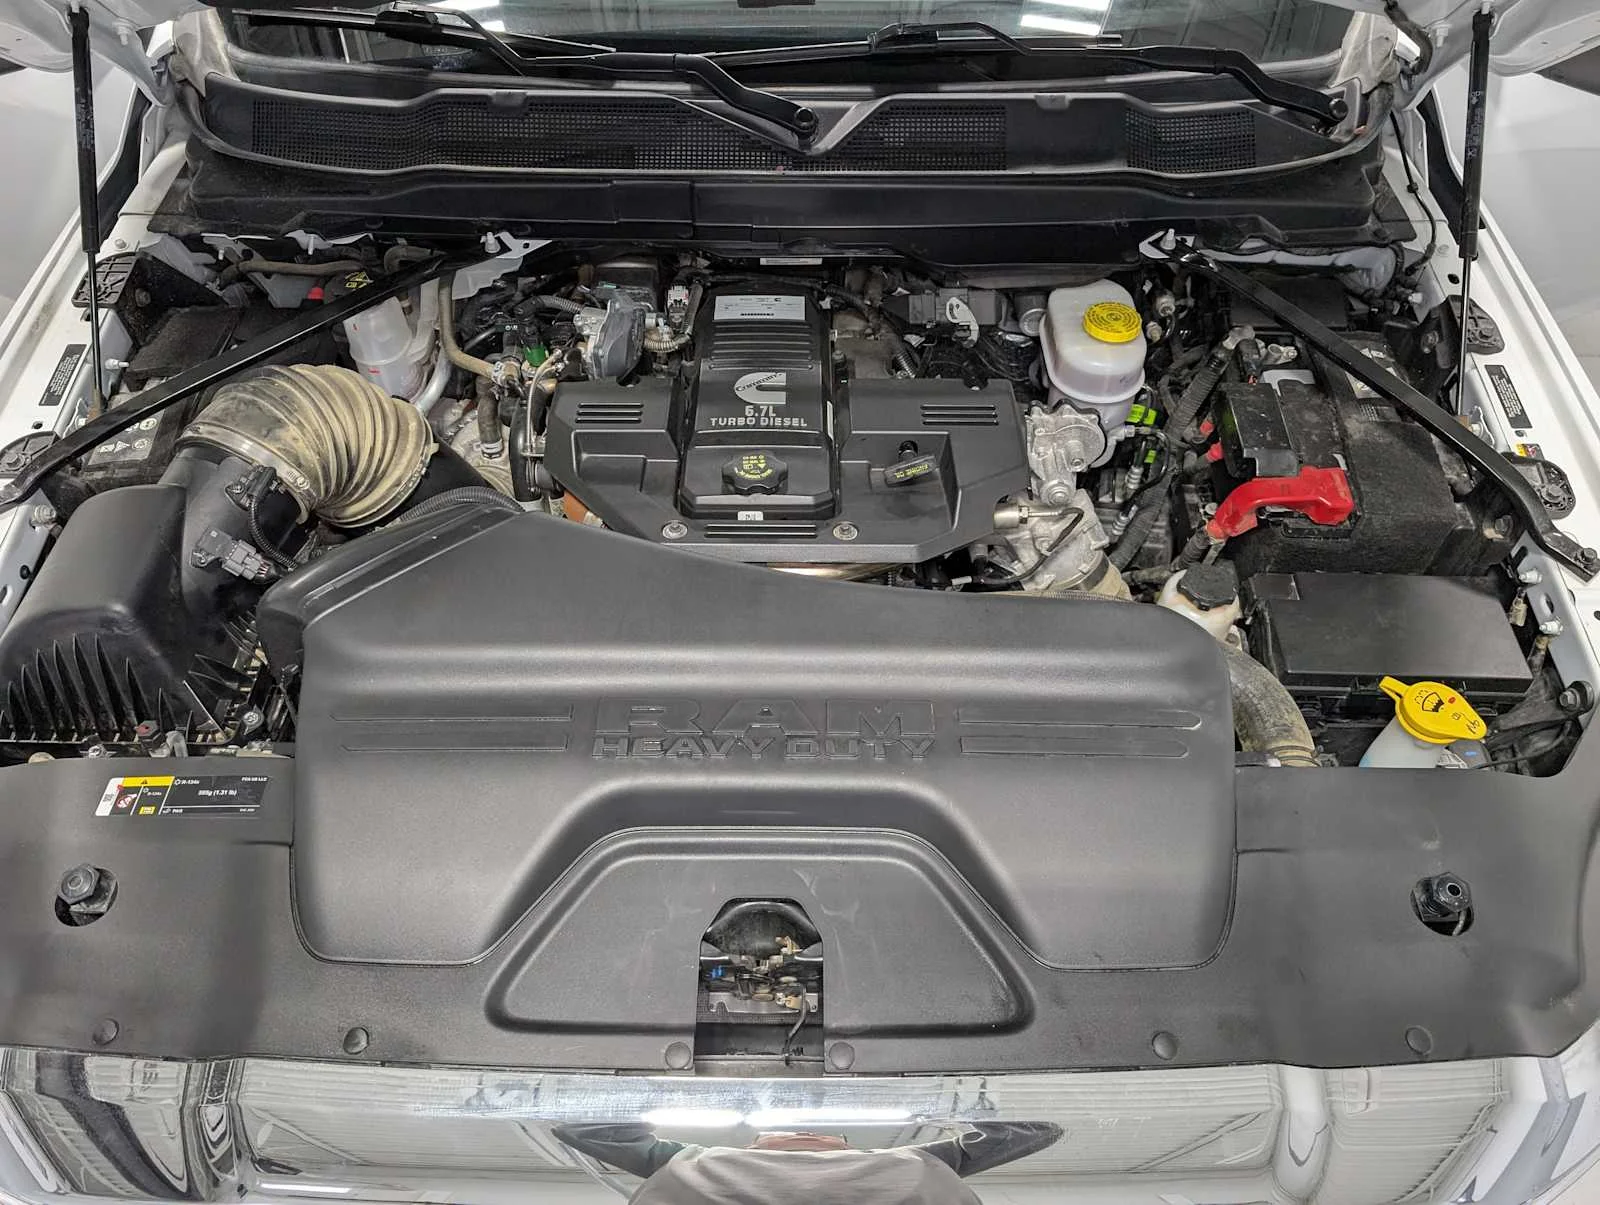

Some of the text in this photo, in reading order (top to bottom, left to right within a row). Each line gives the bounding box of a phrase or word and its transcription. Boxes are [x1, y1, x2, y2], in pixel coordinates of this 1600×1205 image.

[745, 405, 777, 417] 6.7L
[710, 417, 808, 427] TURBO DIESEL
[592, 698, 936, 736] RAM
[591, 736, 936, 760] HEAVY DUTY
